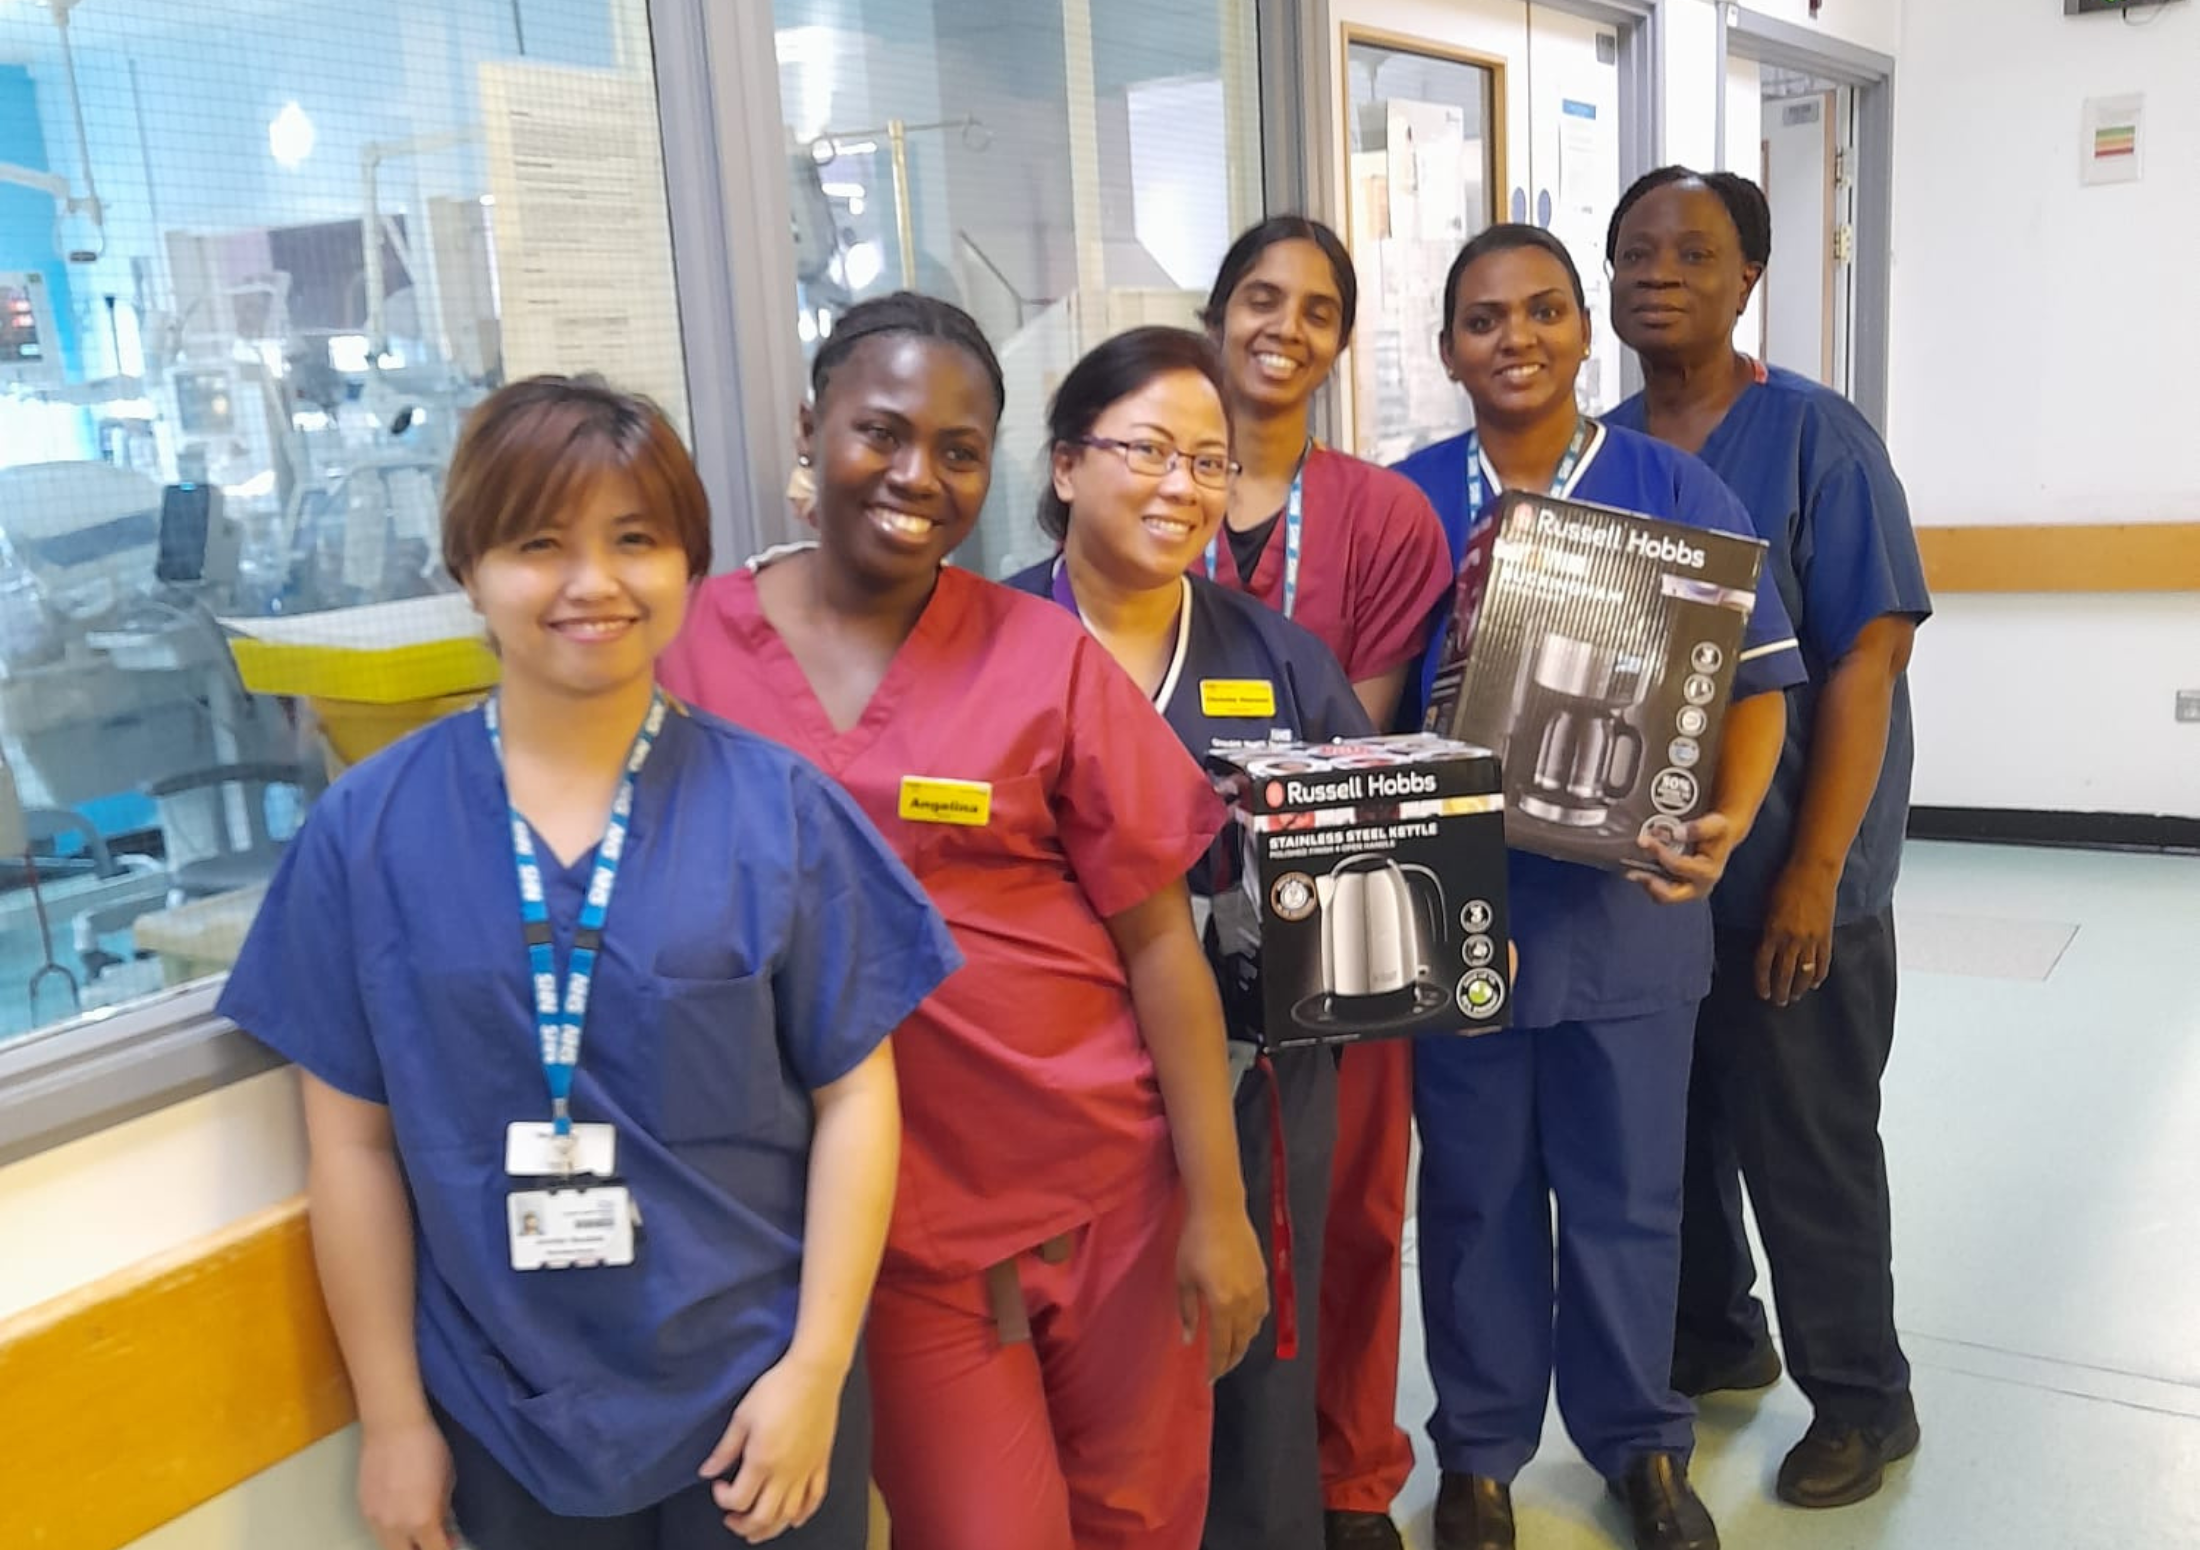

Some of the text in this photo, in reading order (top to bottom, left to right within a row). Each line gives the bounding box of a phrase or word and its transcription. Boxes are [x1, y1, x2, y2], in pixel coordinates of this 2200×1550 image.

[1537, 508, 1706, 568] Russell Hobbs
[1287, 771, 1437, 804] Russell Hobbs
[910, 797, 978, 813] Angelina
[1269, 822, 1438, 850] STAINLESS STEEL KETTLE
